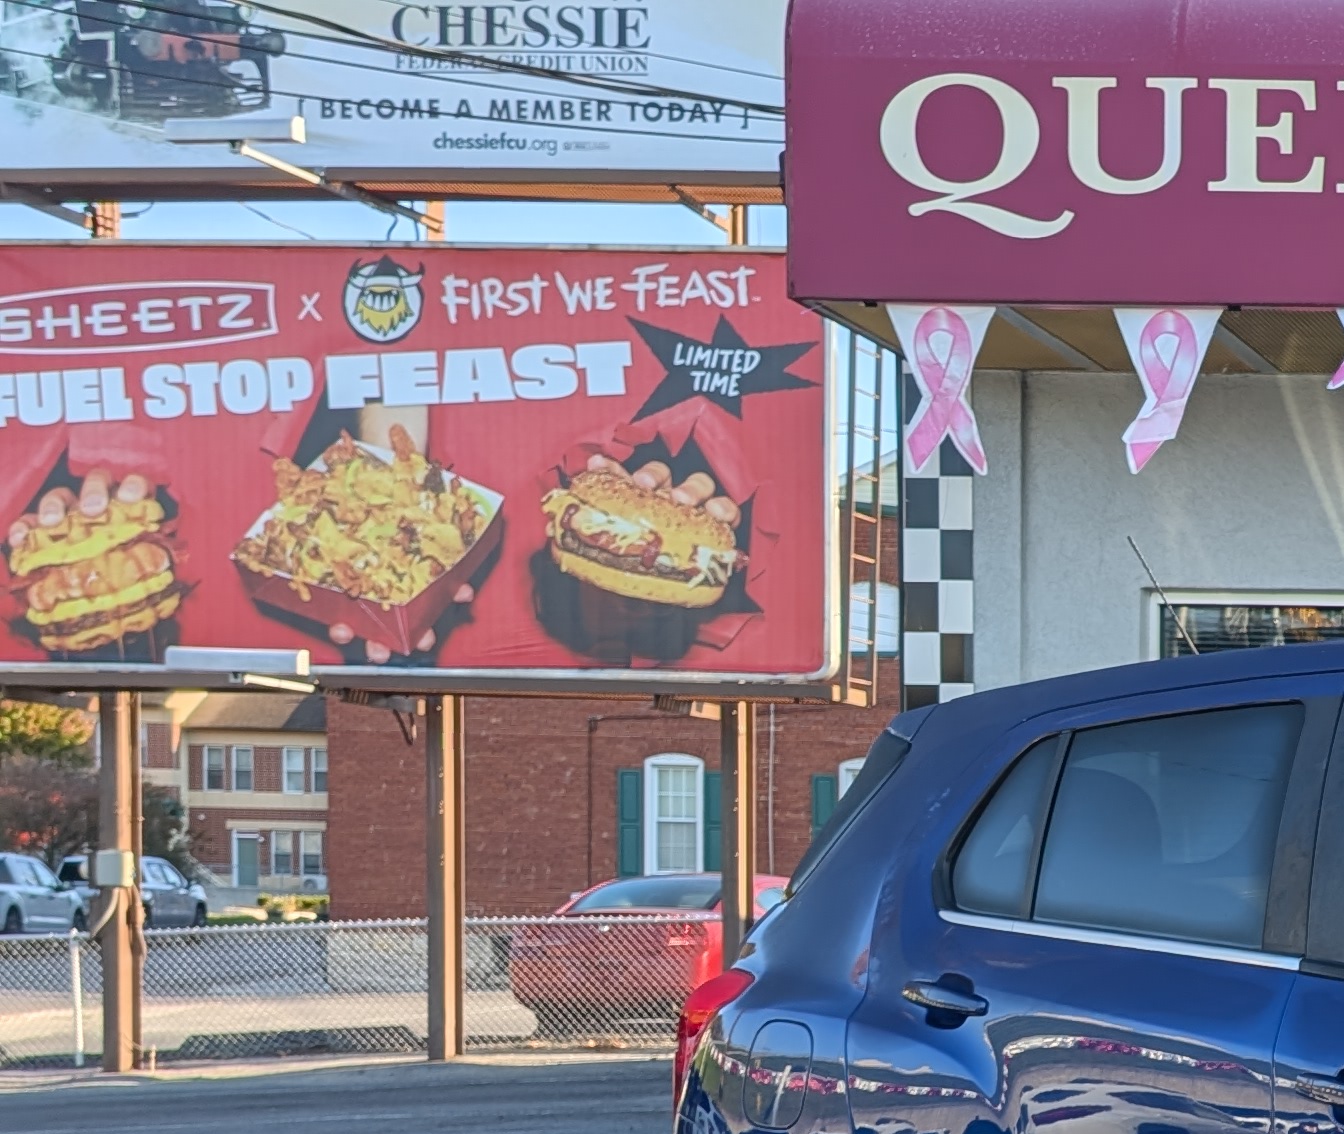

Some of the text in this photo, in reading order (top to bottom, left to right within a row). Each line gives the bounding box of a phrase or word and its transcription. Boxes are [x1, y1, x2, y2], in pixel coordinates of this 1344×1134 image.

[391, 5, 651, 49] CHESSIE
[395, 53, 491, 71] FEDER
[580, 55, 649, 73] UNION
[321, 99, 728, 124] BECOME A MEMBER TODAY
[433, 131, 558, 156] chessiefcu.org
[0, 293, 254, 342] SHEETZ
[441, 273, 549, 324] FIRST
[554, 270, 617, 316] WE
[621, 262, 757, 312] FEAST
[673, 342, 761, 374] LIMITED
[142, 356, 314, 419] STOP
[325, 341, 632, 410] FEAST
[690, 370, 741, 397] TIME
